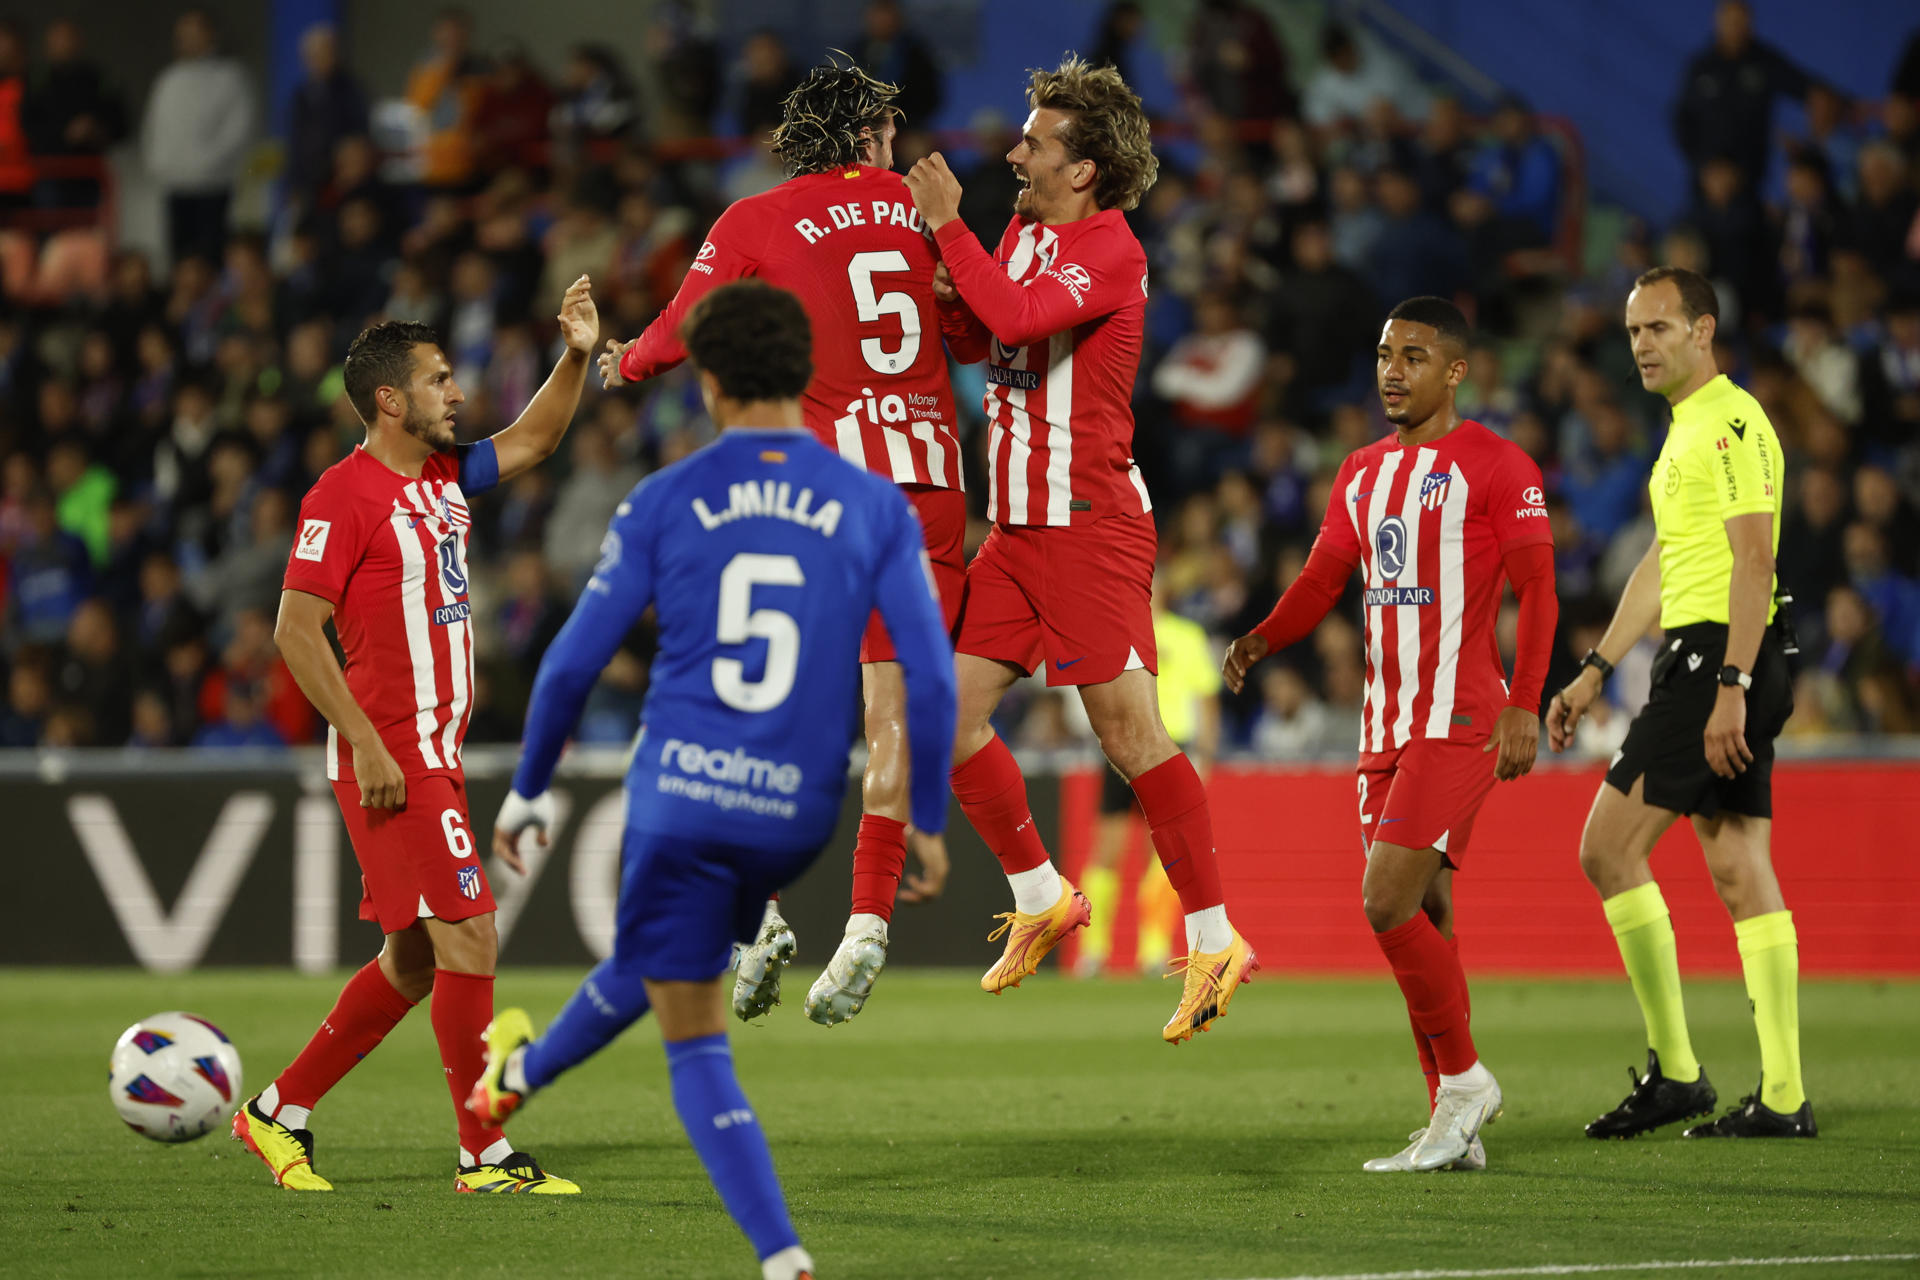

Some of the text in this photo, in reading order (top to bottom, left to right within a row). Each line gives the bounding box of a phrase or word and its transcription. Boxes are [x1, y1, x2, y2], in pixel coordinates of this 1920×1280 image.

[794, 217, 831, 245] R.
[827, 203, 866, 230] DE
[847, 250, 921, 375] 5
[908, 392, 938, 408] Money
[1403, 588, 1431, 604] AIR
[711, 552, 806, 713] 5
[660, 738, 803, 795] realme
[657, 773, 797, 820] smartphone
[441, 808, 472, 858] 6
